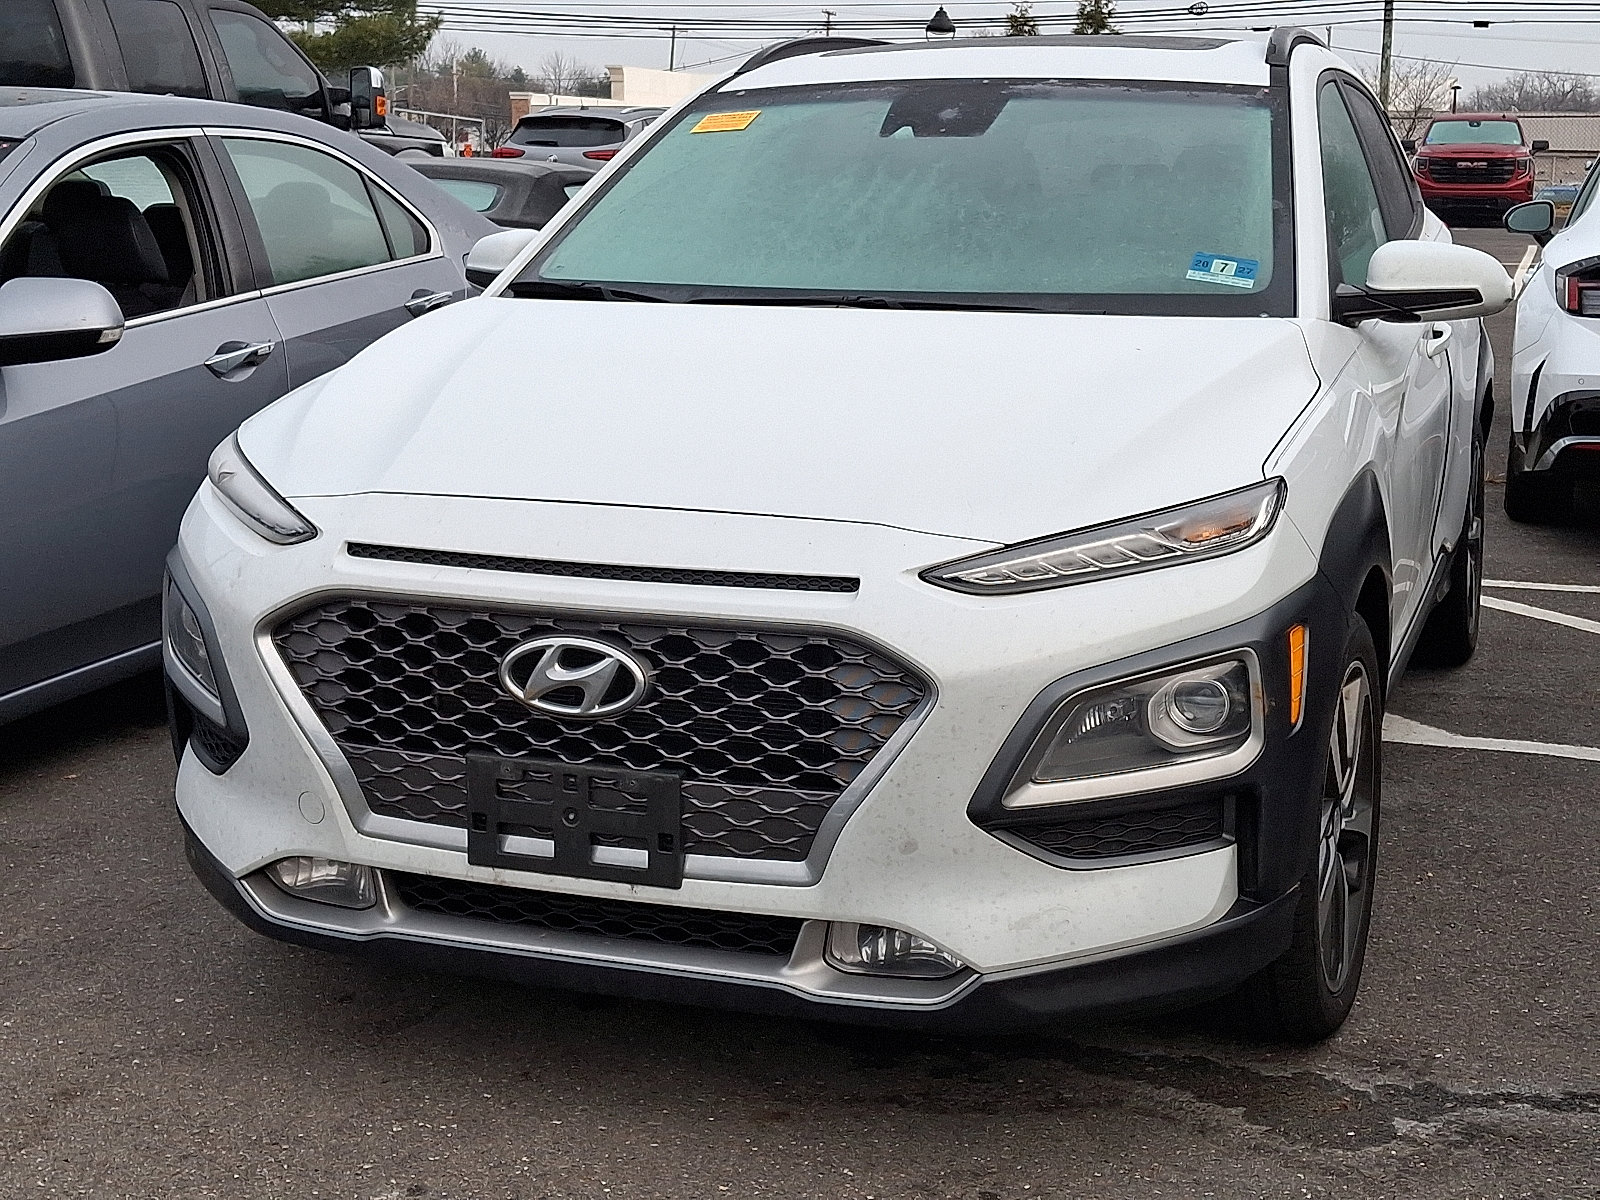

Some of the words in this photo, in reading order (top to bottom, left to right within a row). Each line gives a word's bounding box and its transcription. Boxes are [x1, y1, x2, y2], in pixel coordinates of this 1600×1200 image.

[1195, 260, 1209, 268] 20
[1220, 262, 1229, 272] 7
[1238, 266, 1254, 275] 27
